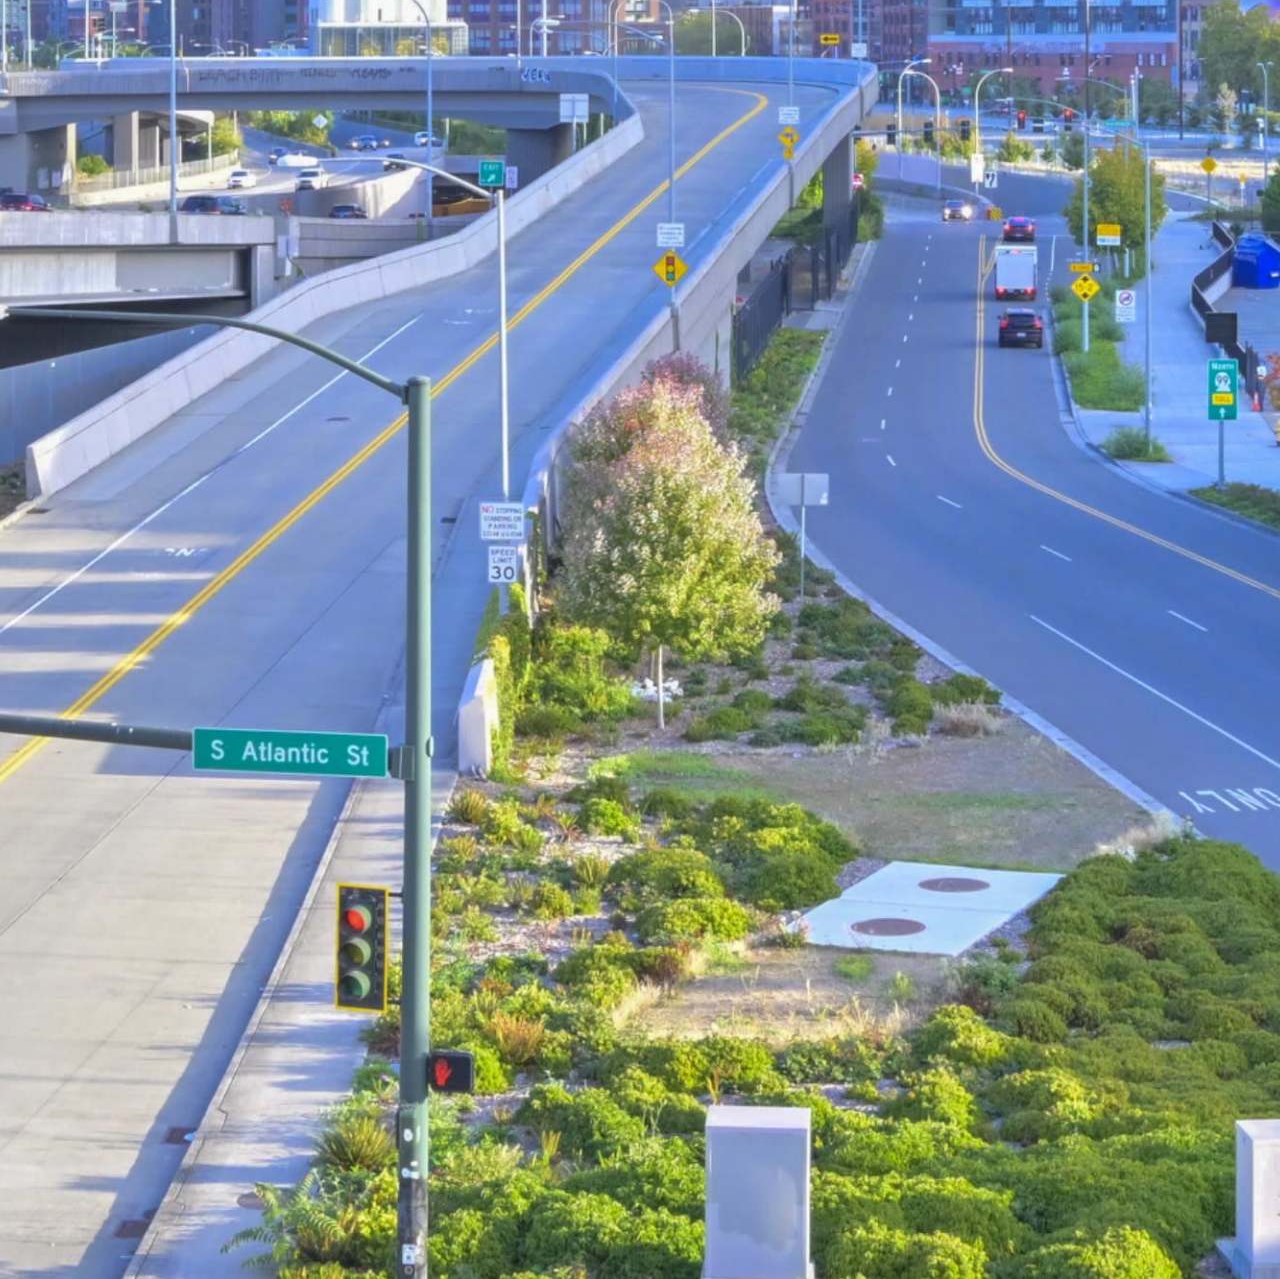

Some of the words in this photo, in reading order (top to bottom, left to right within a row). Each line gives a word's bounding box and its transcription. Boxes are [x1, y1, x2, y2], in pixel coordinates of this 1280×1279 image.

[481, 505, 494, 513] NO
[491, 565, 515, 580] 30
[210, 739, 224, 760] S
[242, 741, 329, 764] Atlantic
[347, 744, 370, 766] St
